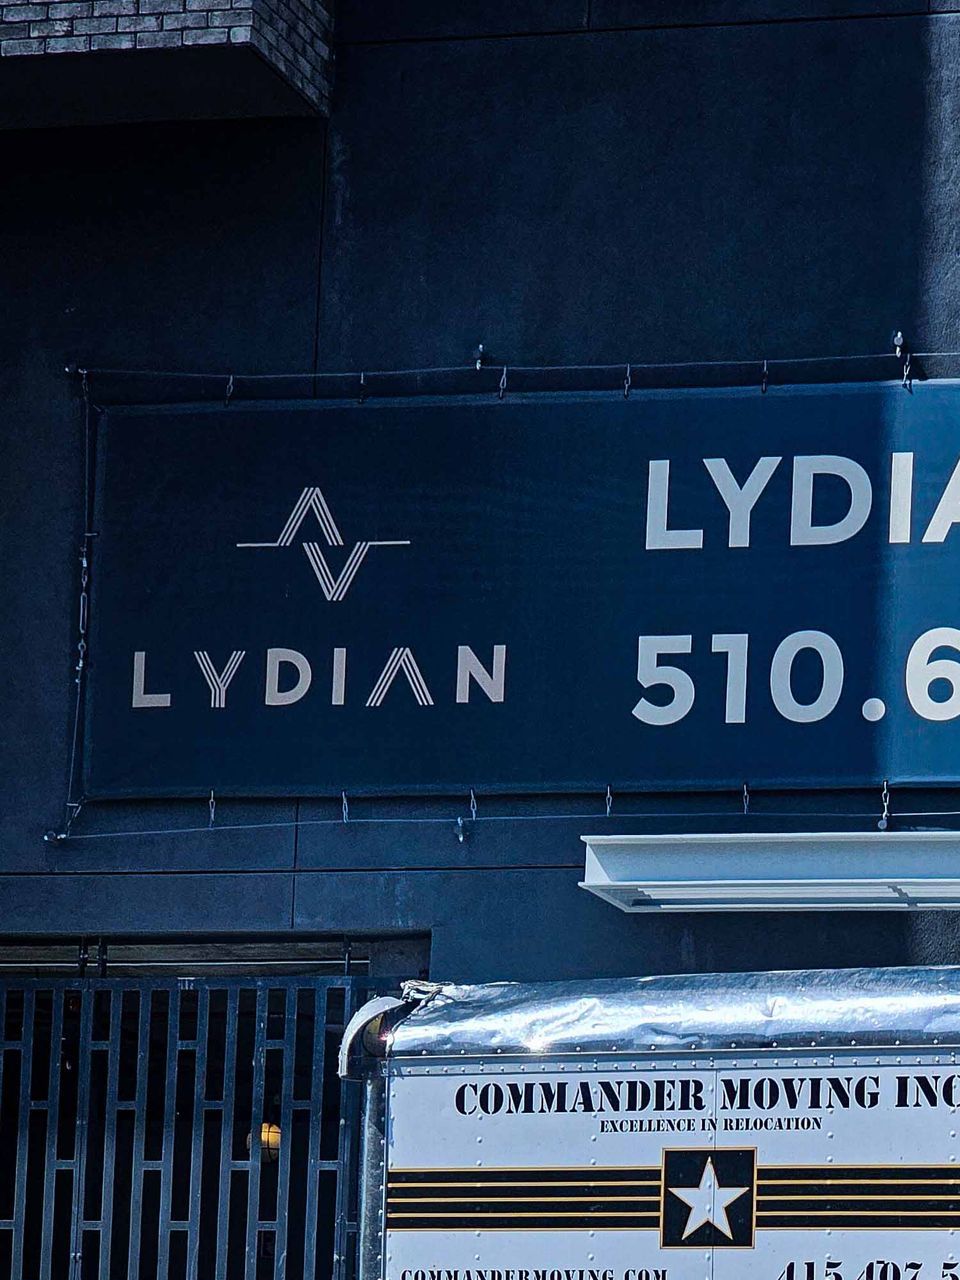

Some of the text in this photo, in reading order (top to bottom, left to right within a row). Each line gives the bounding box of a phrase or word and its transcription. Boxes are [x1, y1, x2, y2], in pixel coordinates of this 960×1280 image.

[132, 644, 507, 708] LYDIAN
[456, 1080, 706, 1116] COMMANDER
[720, 1076, 880, 1110] MOVING
[600, 1116, 823, 1132] EXCELLENCE IN RELOCATION
